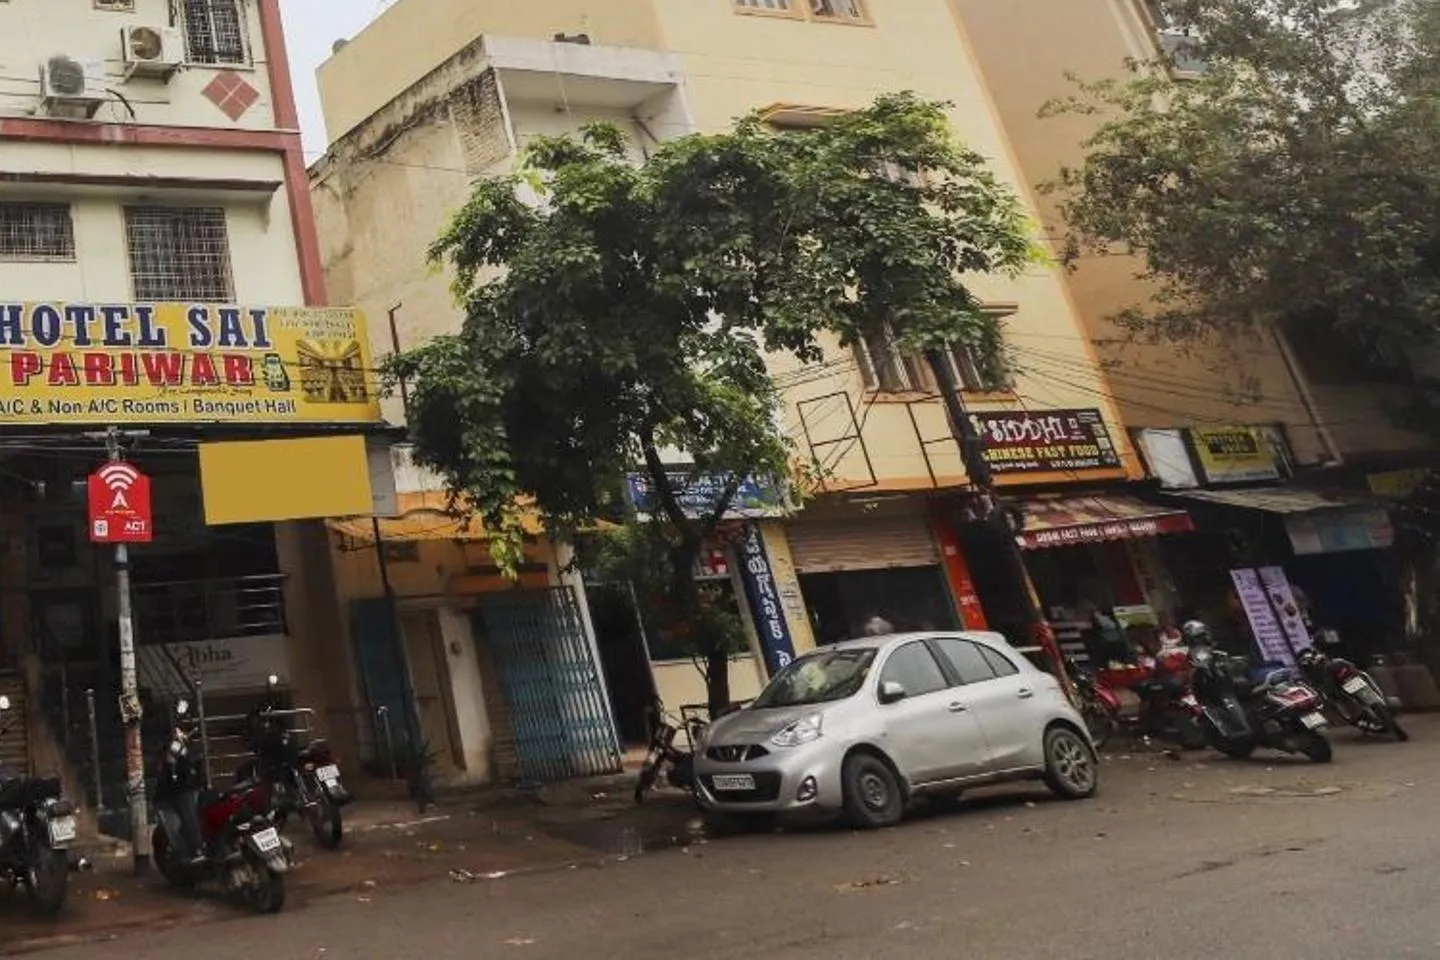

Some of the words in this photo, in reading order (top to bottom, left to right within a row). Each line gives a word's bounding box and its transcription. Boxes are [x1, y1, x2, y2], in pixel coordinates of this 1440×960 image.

[187, 307, 272, 349] SAI
[9, 351, 255, 387] PARIWAR
[30, 401, 44, 415] &
[48, 400, 82, 414] Non
[122, 399, 179, 414] Rooms
[193, 399, 262, 416] Banquet
[265, 399, 297, 413] Hall
[988, 415, 1068, 443] SIDDHI
[1036, 445, 1066, 459] FAST
[1068, 444, 1099, 457] FOOD
[124, 520, 146, 531] ACT
